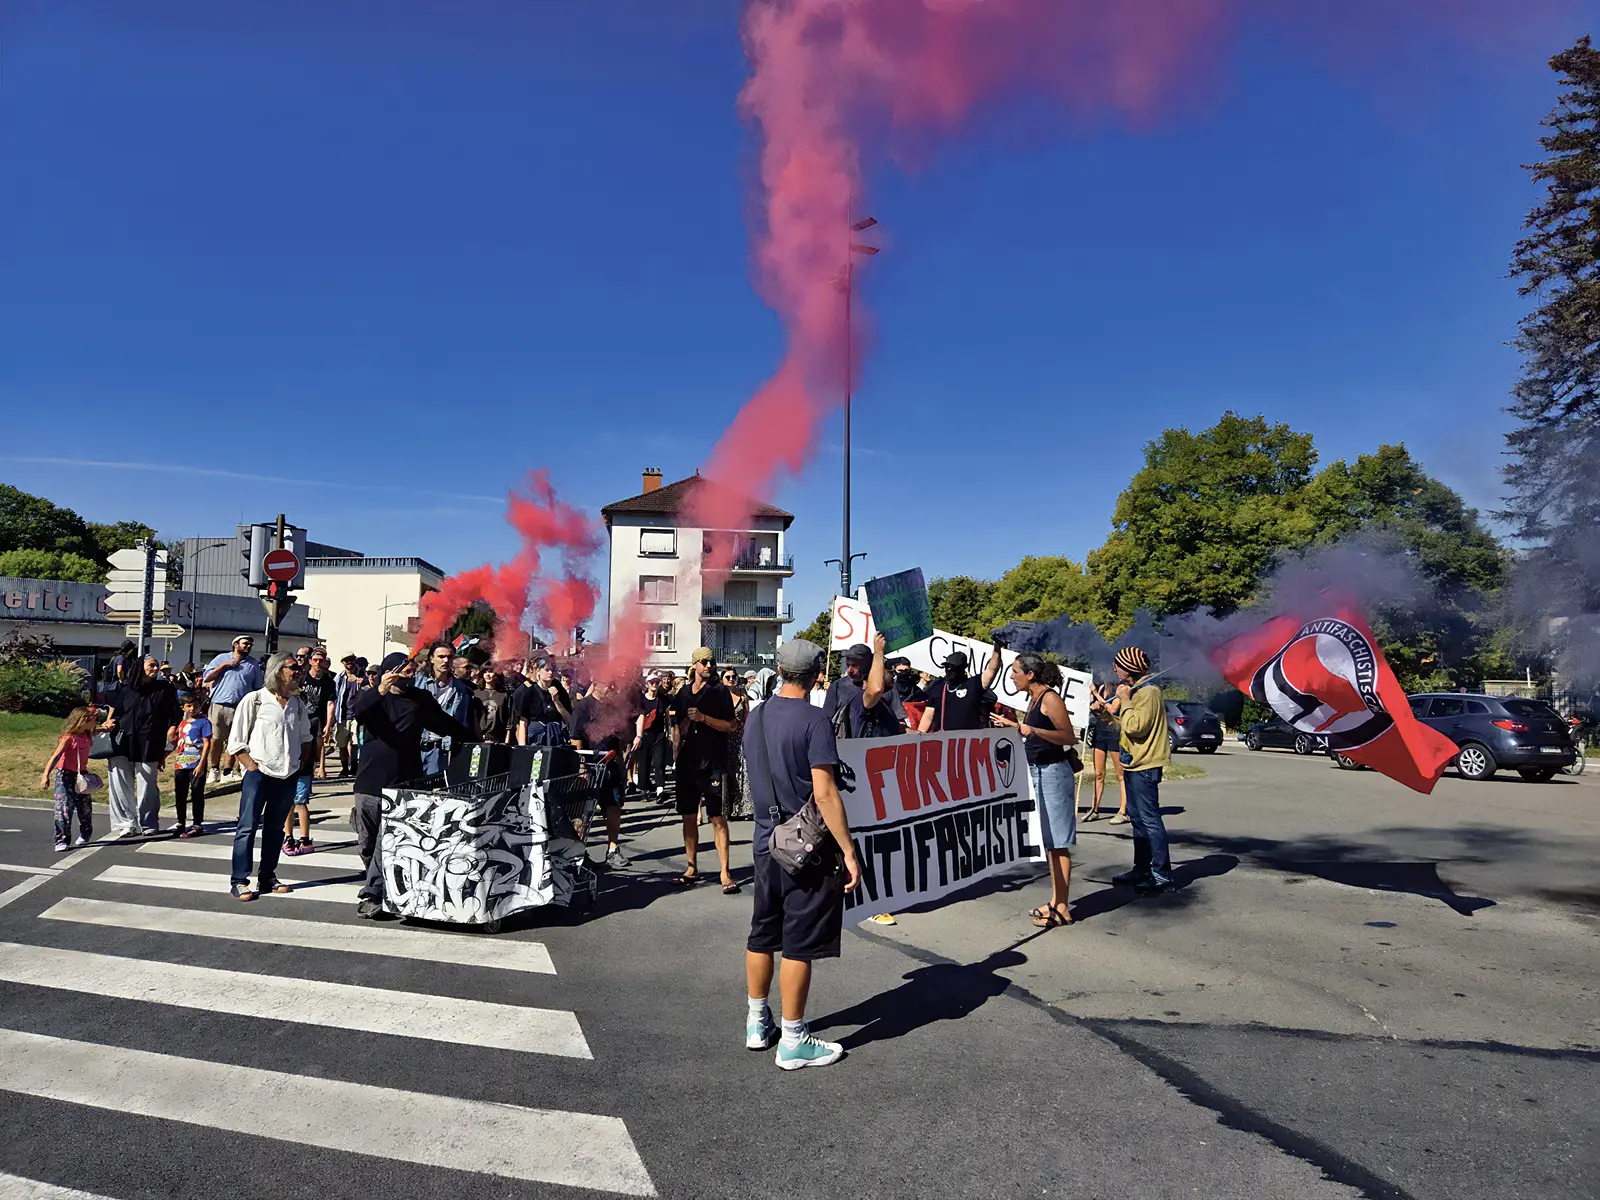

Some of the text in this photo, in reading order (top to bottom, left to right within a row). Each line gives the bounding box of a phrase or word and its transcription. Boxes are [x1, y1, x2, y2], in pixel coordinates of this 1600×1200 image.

[835, 605, 872, 643] ST
[930, 636, 1083, 715] GNOCE
[865, 738, 996, 821] FORUM
[845, 799, 1040, 910] NTIFASCISTE
